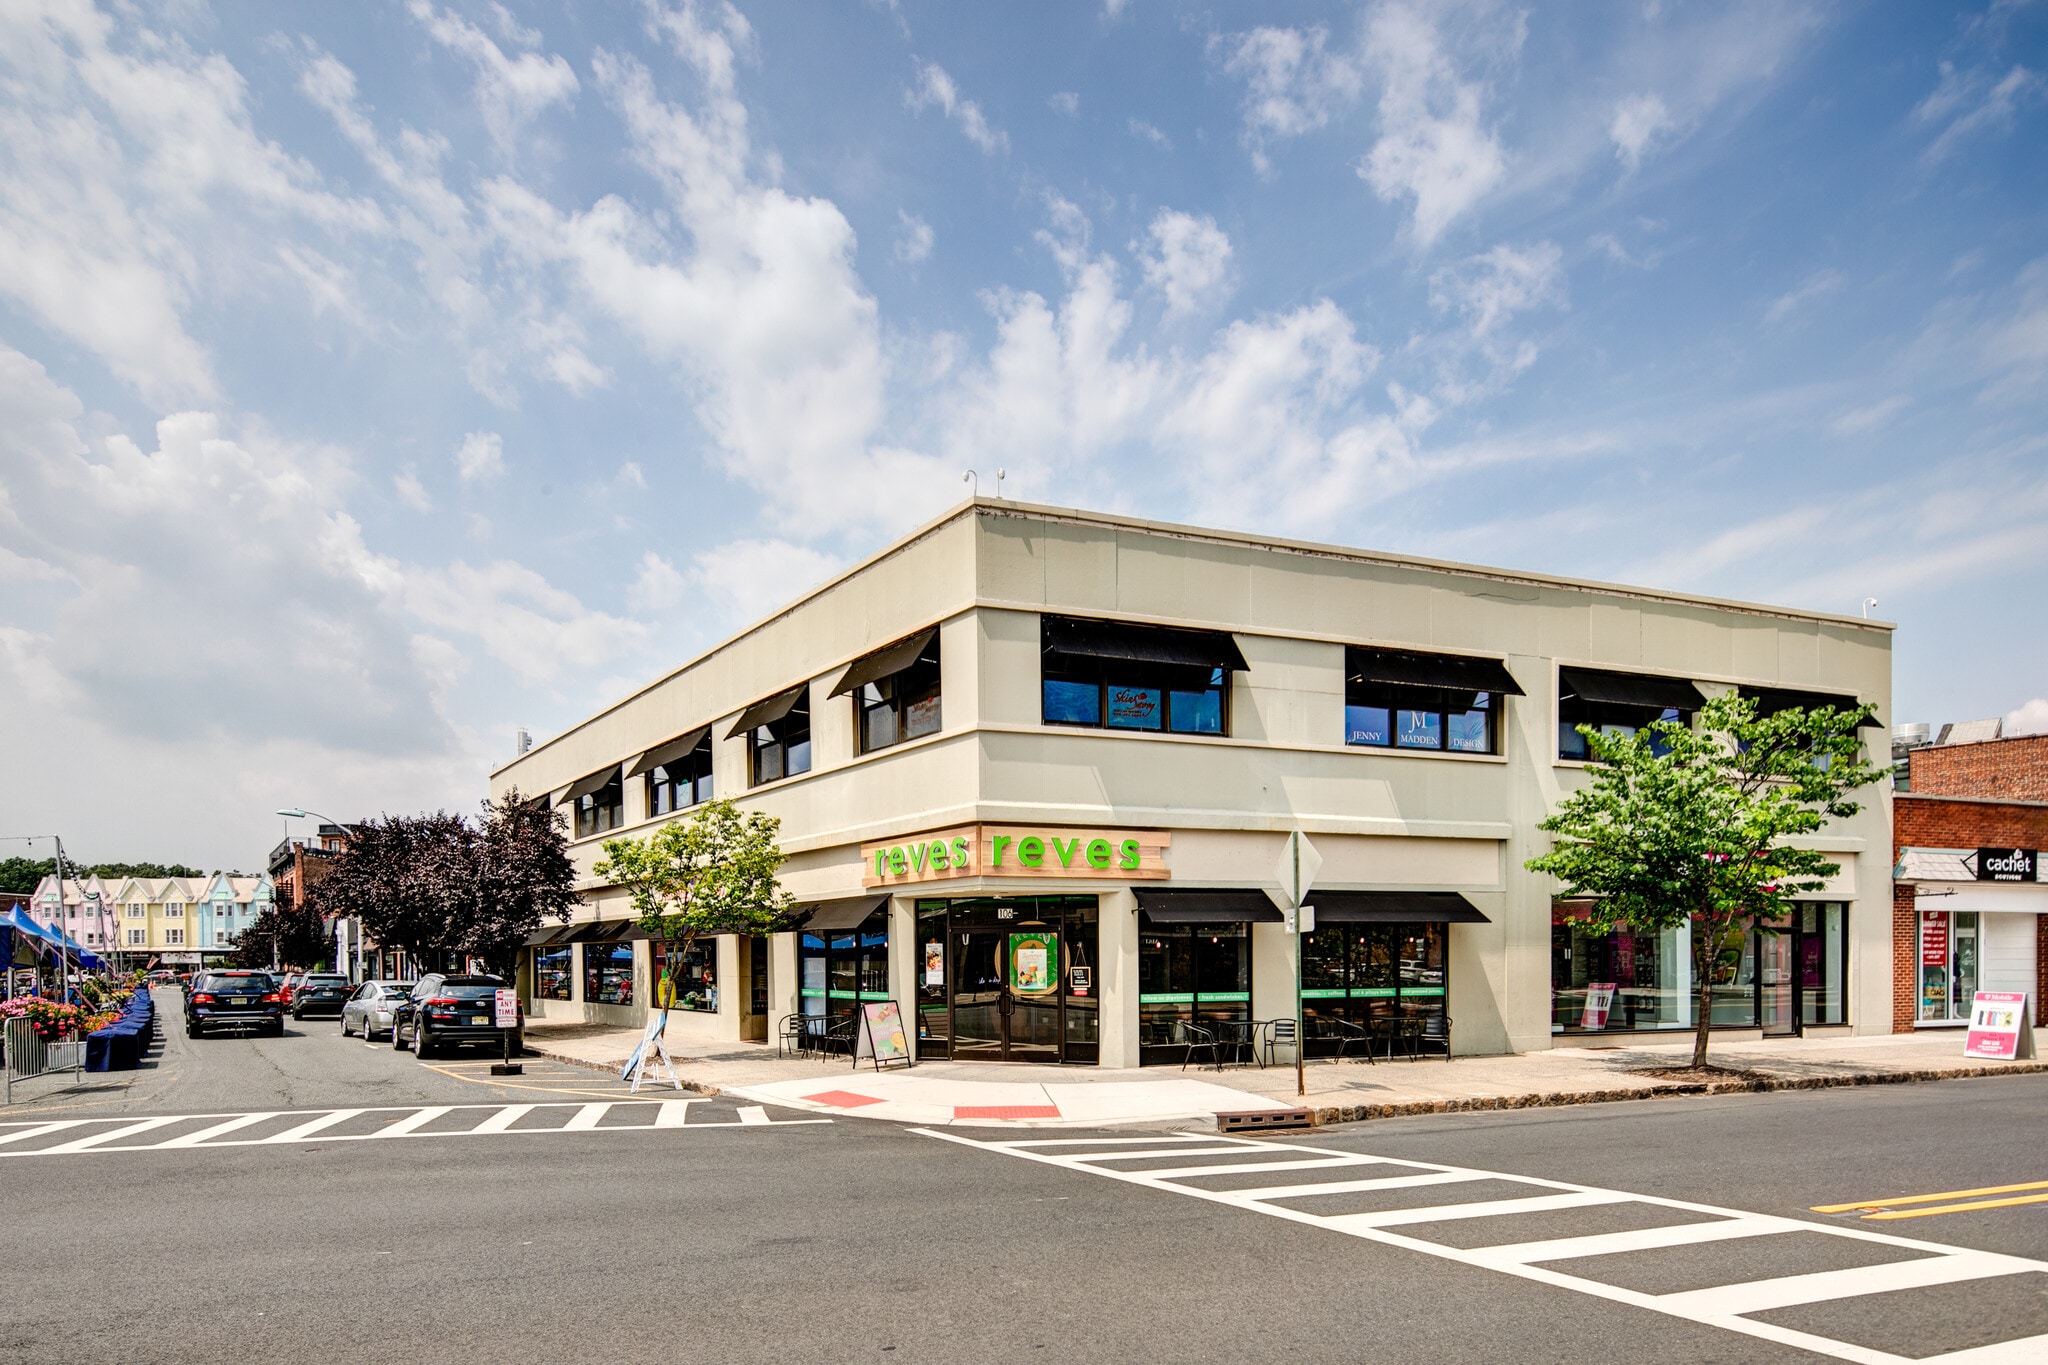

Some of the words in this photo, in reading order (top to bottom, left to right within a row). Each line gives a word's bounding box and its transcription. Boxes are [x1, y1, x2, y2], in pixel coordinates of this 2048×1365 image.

[1352, 730, 1381, 741] JENNY
[1400, 734, 1438, 745] MADDEN
[1453, 737, 1484, 748] DESIGN
[875, 836, 969, 877] reves
[992, 835, 1141, 870] reves
[1986, 855, 2031, 873] cachet
[1000, 908, 1013, 919] 106
